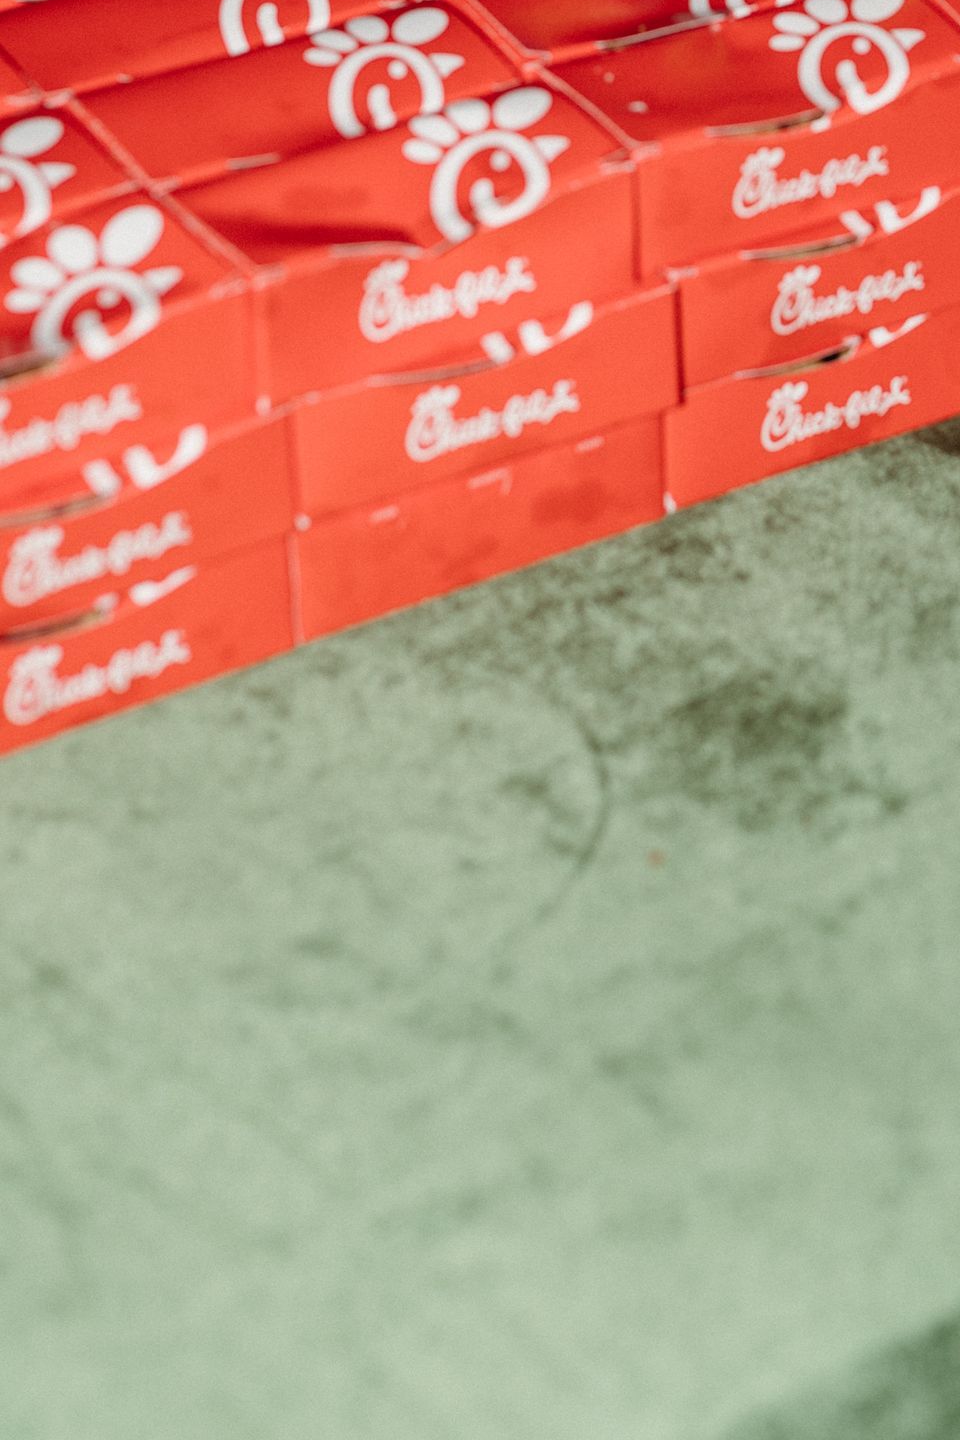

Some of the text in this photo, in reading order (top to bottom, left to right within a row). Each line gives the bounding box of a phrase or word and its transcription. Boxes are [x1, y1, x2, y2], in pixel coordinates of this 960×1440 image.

[732, 145, 890, 219] Chick-fil-A
[770, 262, 925, 335] Chick-fil-A
[0, 383, 143, 462] hick-fil-A
[760, 376, 912, 451] Chick-fil-A
